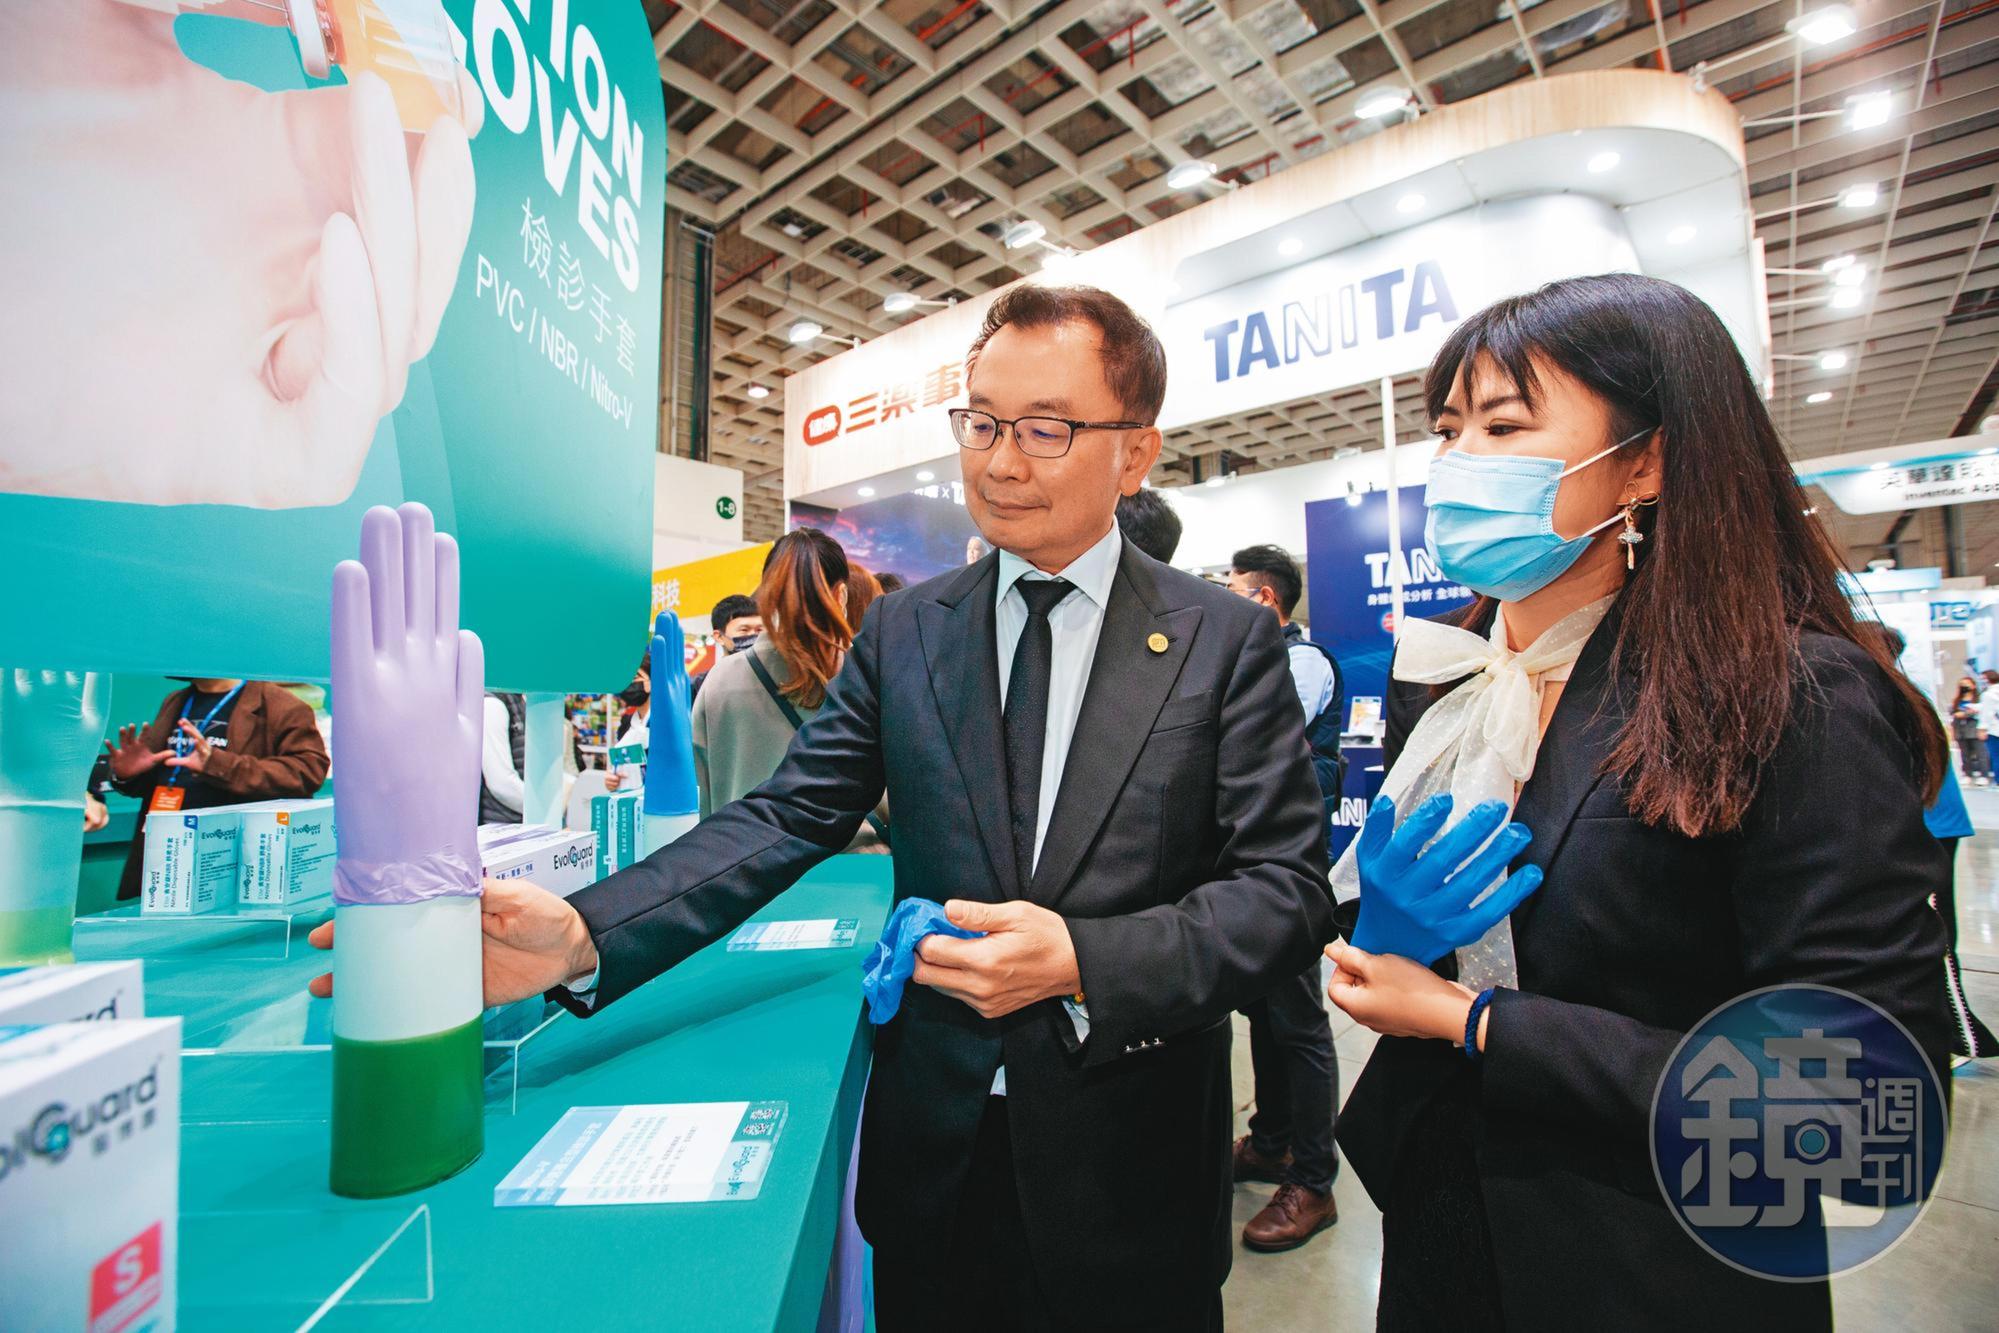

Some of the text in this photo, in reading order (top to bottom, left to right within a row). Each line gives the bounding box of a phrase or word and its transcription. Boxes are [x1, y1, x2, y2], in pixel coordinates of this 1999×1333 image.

[441, 0, 640, 292] OVES
[513, 0, 643, 208] ION
[476, 253, 525, 334] PVC
[541, 315, 579, 385] NBR
[590, 369, 634, 431] Nitro-V
[519, 197, 637, 378] 檢診手套
[1203, 258, 1460, 383] TANITA
[1364, 548, 1450, 588] TAN
[553, 845, 593, 870] EvolGuard
[115, 1244, 143, 1296] S
